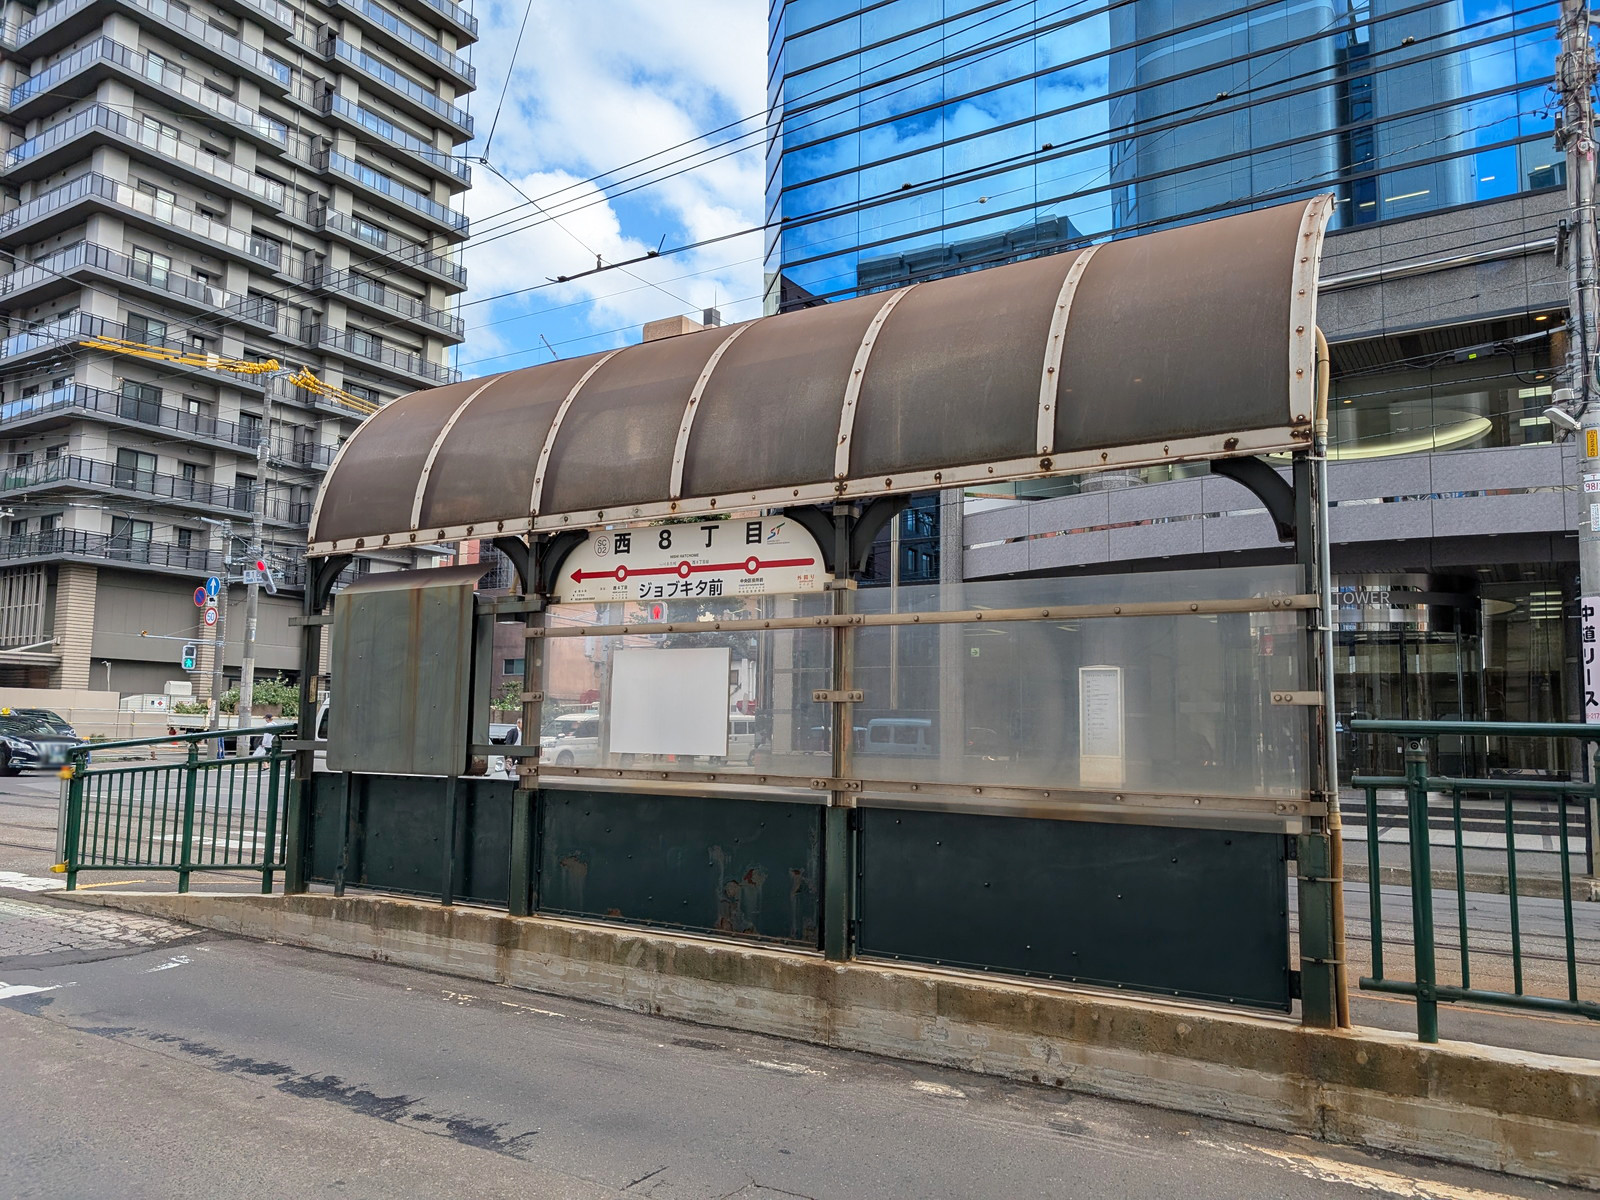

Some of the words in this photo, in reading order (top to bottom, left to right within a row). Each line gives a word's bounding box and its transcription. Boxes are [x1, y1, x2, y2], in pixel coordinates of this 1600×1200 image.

[597, 539, 607, 547] SC
[614, 521, 762, 554] 西8丁目
[639, 578, 724, 599] ジョブキタ前
[1333, 592, 1390, 604] TOWER
[1582, 605, 1599, 706] 中道リース
